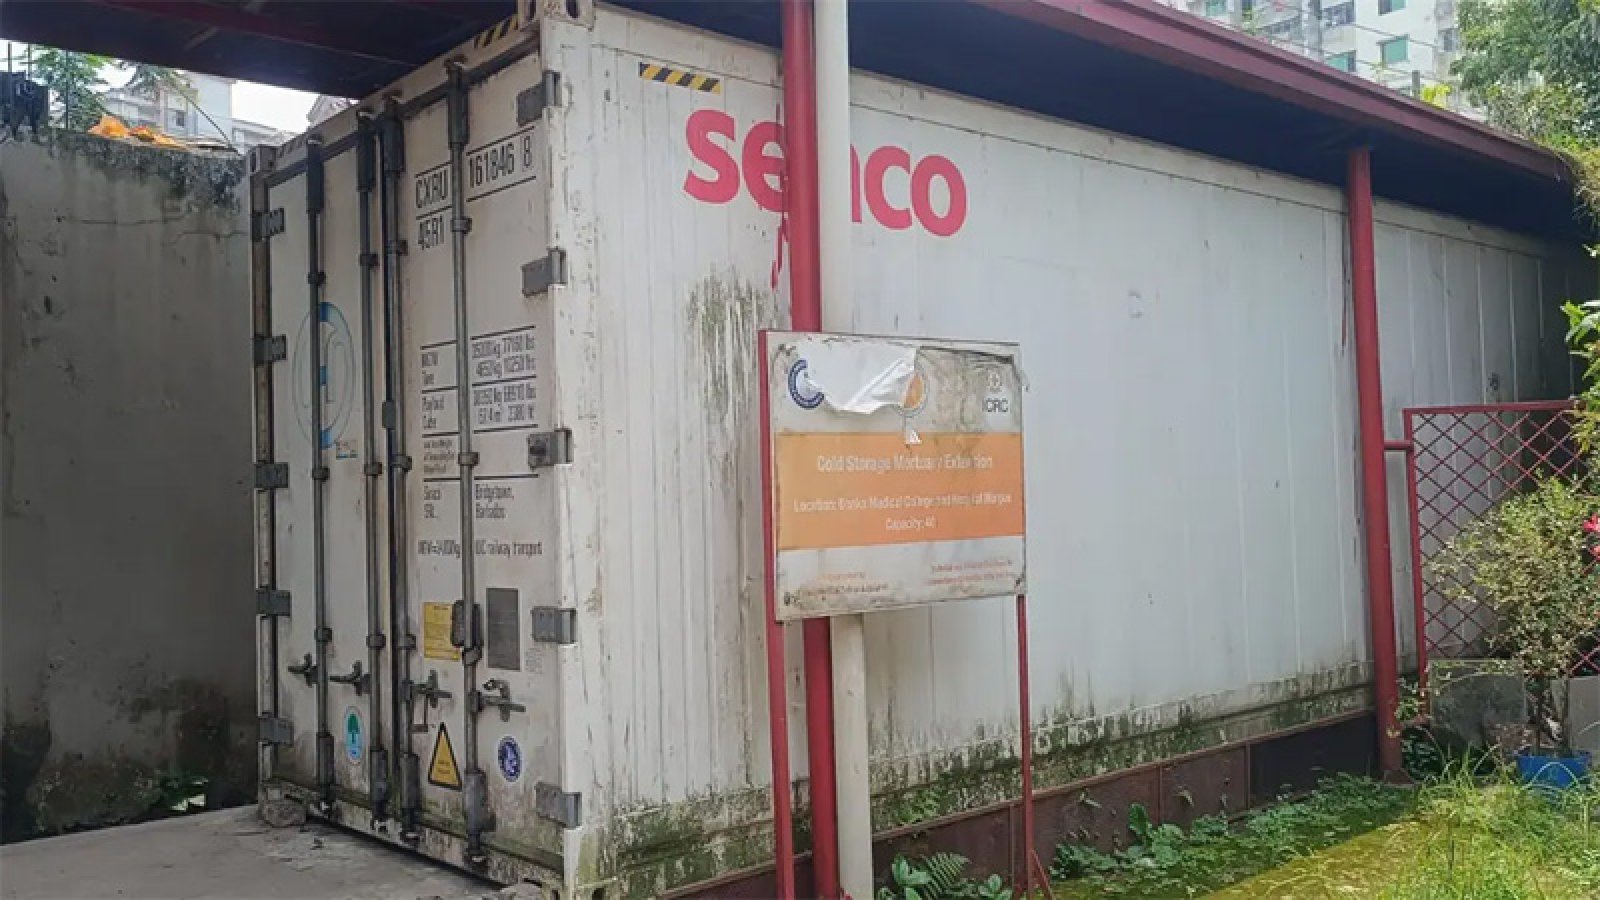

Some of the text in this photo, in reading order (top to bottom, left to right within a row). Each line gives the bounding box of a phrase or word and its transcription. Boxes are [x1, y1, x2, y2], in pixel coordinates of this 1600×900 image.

[415, 135, 533, 209] CXRU 161846 8
[684, 108, 967, 237] seco
[817, 455, 843, 473] Cold
[844, 455, 891, 476] Storage
[944, 453, 993, 470] Extenion
